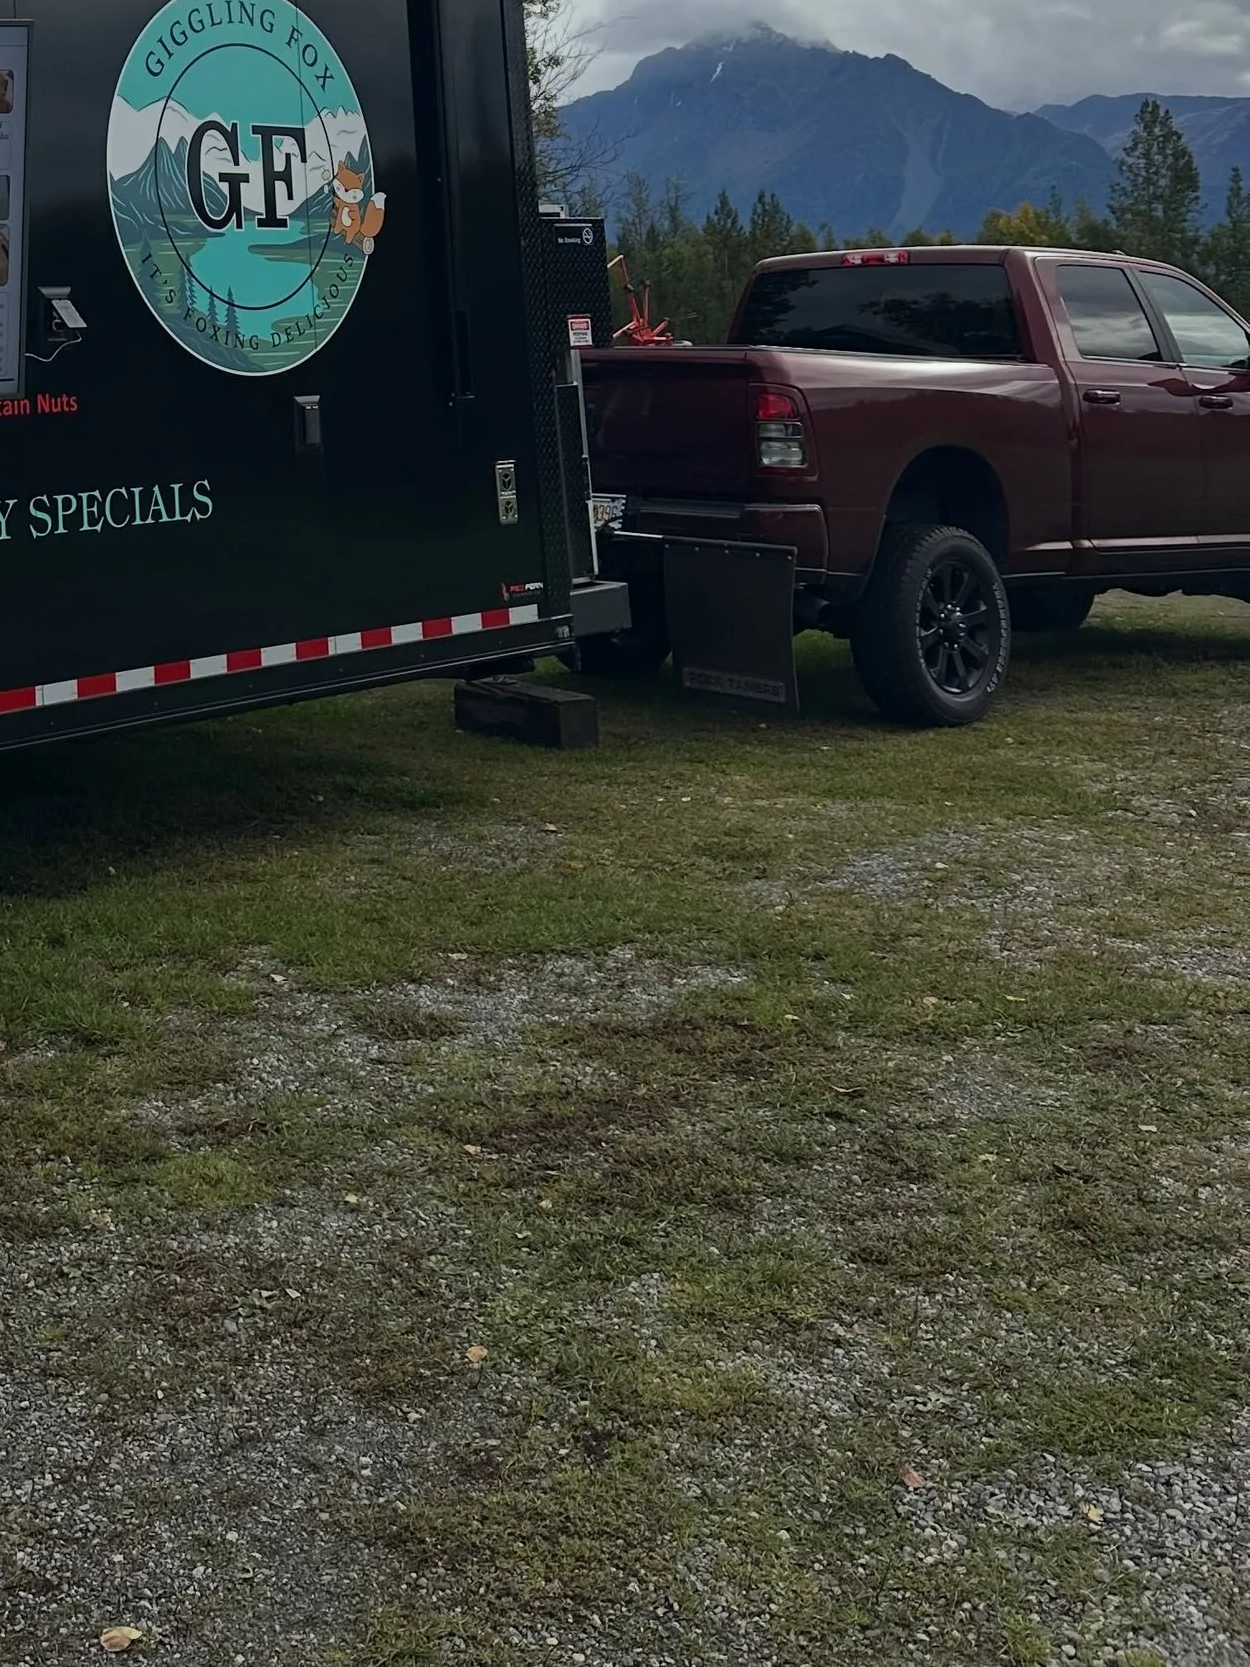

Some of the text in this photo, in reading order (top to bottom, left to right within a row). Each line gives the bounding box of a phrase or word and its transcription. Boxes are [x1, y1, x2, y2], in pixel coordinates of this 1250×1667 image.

[145, 0, 335, 93] GIGGLING FOX
[184, 119, 308, 232] GF
[139, 253, 355, 352] IT'S FOXING DELICIOUS
[36, 392, 78, 414] Nuts
[28, 479, 214, 542] SPECIALS
